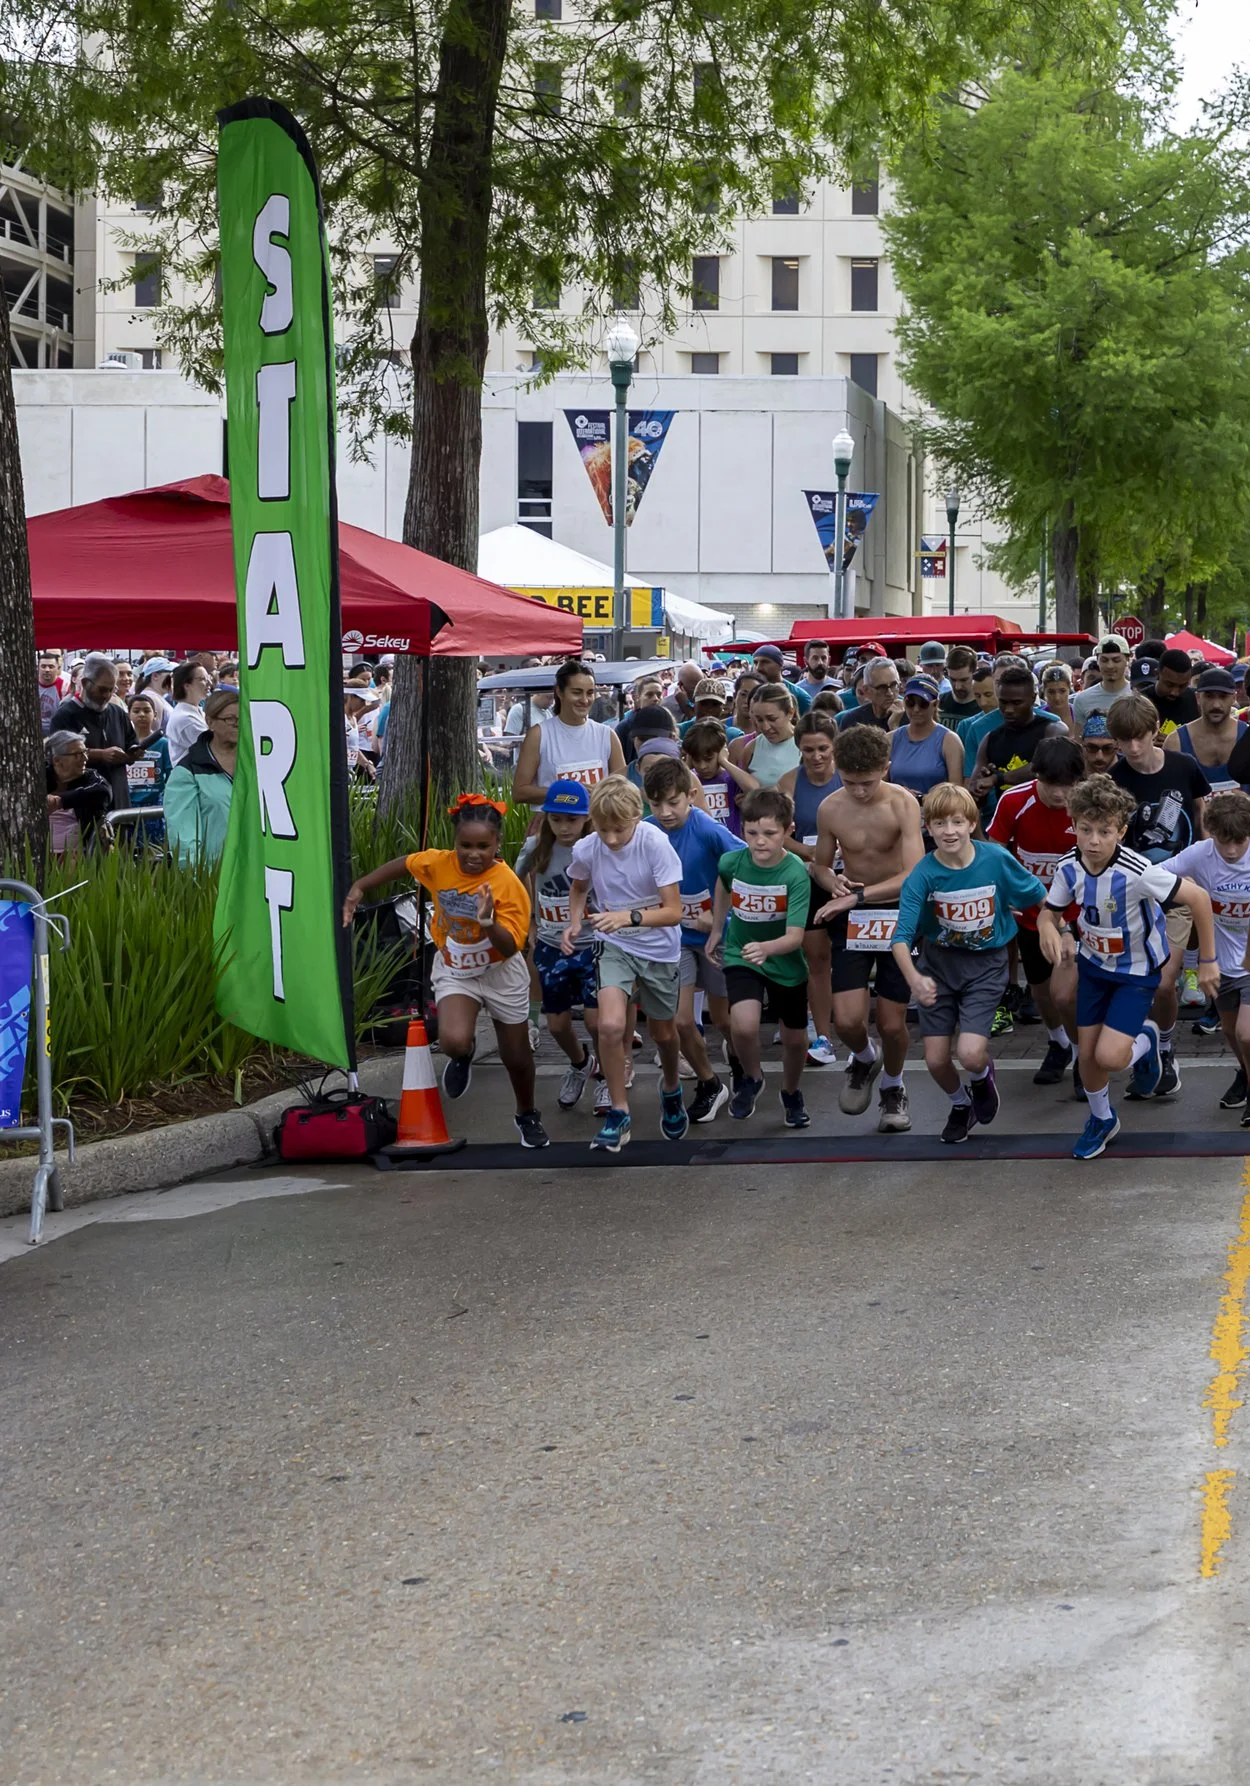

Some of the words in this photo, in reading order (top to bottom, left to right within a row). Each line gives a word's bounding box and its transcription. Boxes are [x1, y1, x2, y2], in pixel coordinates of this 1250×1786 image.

[246, 195, 305, 1003] START
[558, 595, 615, 618] BEE
[1114, 626, 1142, 640] STOP
[126, 768, 148, 779] 386
[739, 893, 777, 912] 256
[939, 899, 990, 921] 1209
[541, 905, 587, 922] 115
[856, 920, 896, 939] 247
[449, 951, 489, 969] 940
